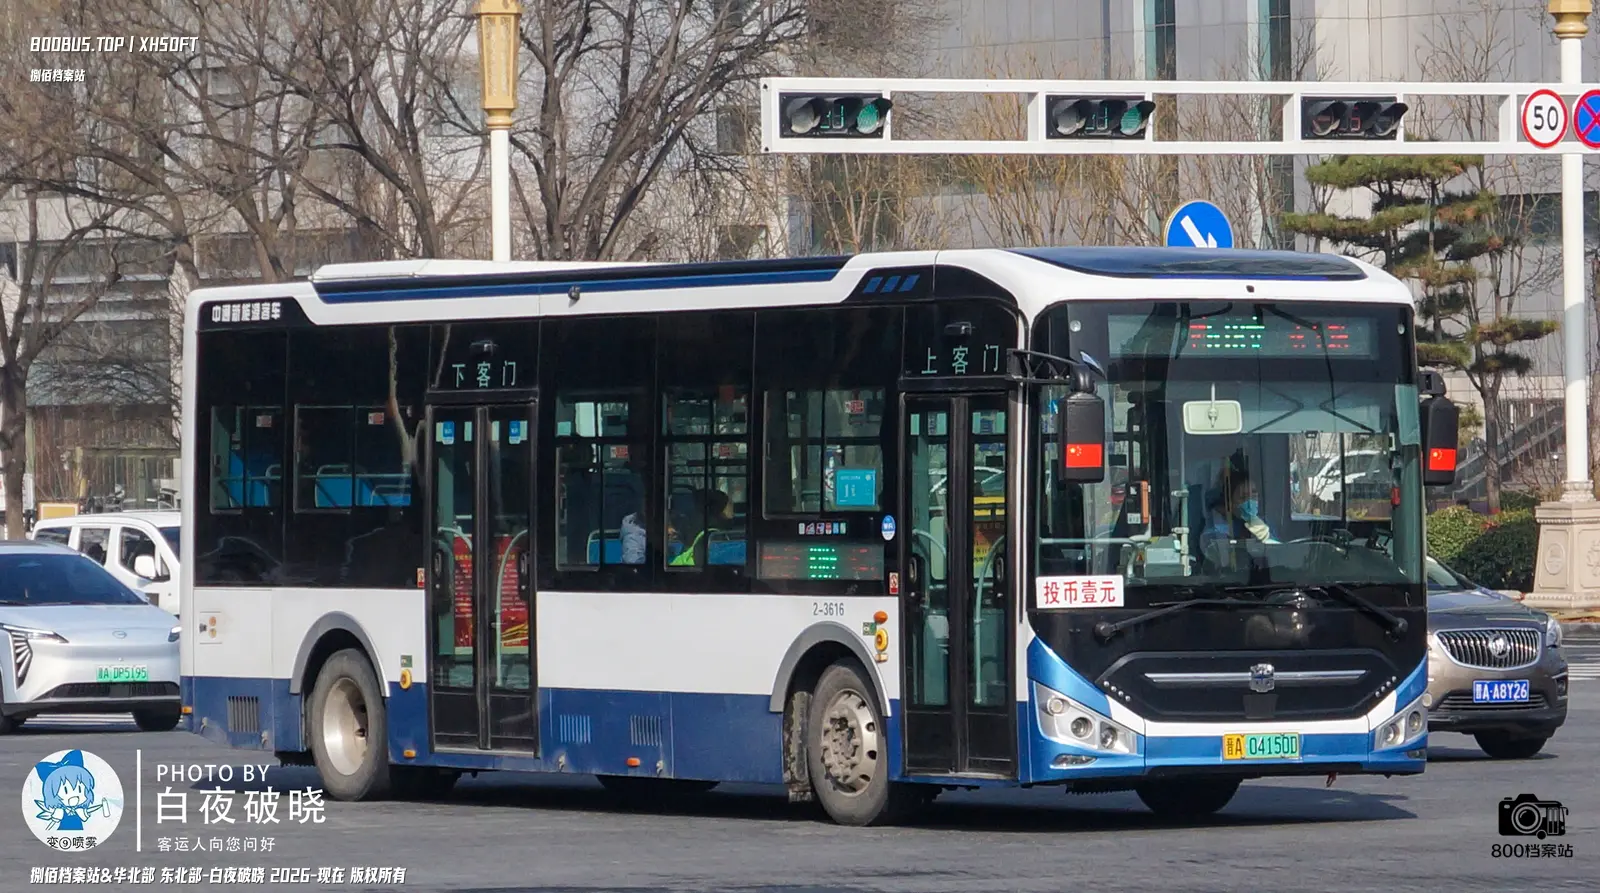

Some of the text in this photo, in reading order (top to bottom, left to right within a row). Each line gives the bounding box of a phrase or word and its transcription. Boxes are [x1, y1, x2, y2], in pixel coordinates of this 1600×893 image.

[1534, 105, 1559, 131] 50
[921, 343, 999, 375] 上客门
[451, 360, 517, 389] 下客门
[1043, 580, 1117, 605] 投币壹元
[812, 602, 845, 617] 2-3616
[1226, 736, 1298, 756] 晋A 04150D
